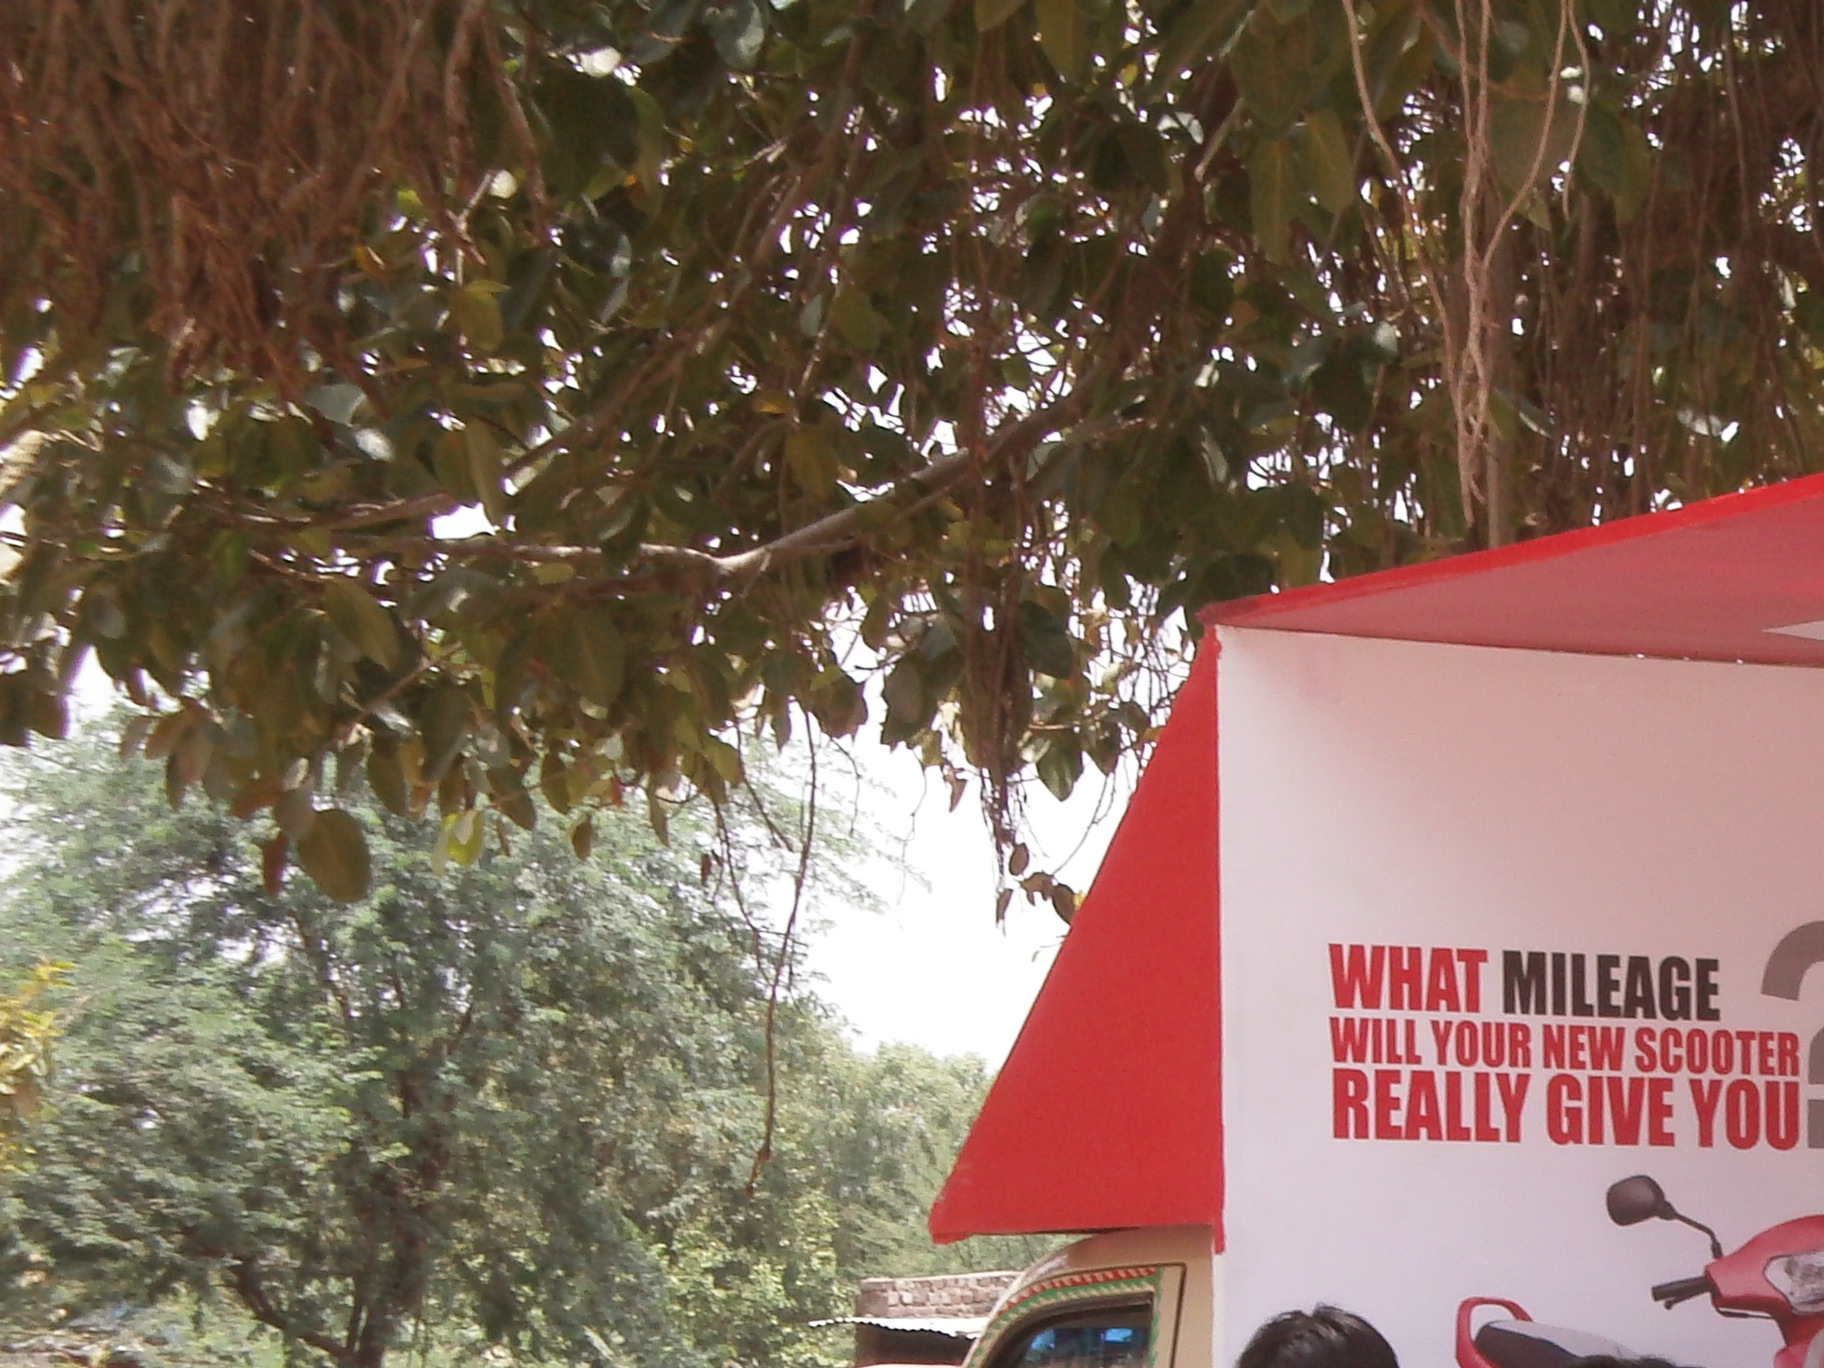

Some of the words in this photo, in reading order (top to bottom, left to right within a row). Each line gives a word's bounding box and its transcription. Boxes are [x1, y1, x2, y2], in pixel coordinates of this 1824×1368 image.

[1328, 943, 1488, 1013] WHAT
[1502, 950, 1720, 1021] MILEAGE
[1329, 1017, 1422, 1064] WILL
[1429, 1020, 1531, 1068] YOUR
[1542, 1024, 1625, 1071] NEW
[1635, 1027, 1800, 1076] SCOOTER
[1333, 1068, 1531, 1142] REALLY
[1546, 1073, 1675, 1147] GIVE
[1689, 1078, 1800, 1150] YOU
